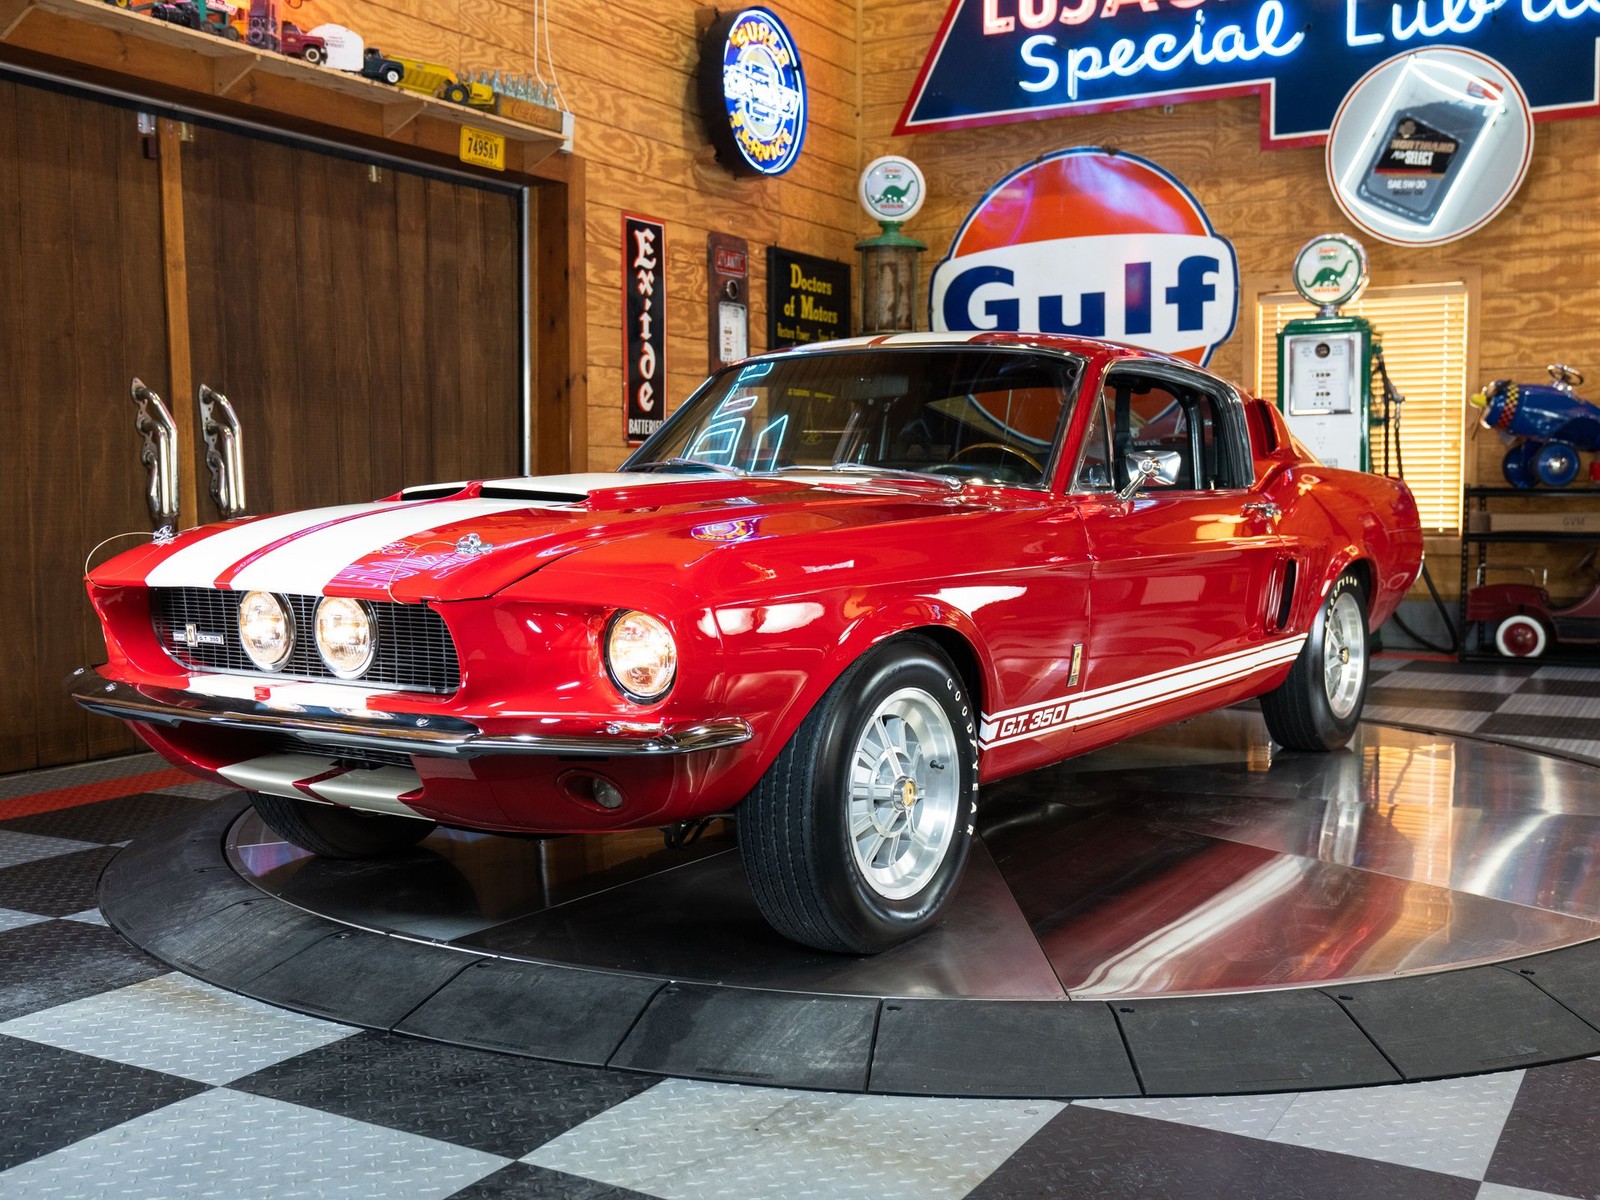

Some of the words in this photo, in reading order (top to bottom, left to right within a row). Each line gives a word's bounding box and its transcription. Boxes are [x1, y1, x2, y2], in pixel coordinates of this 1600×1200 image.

[731, 21, 790, 68] SUPER
[1019, 0, 1305, 100] Special
[790, 263, 832, 295] Doctors
[943, 255, 1219, 337] Gulf
[634, 228, 656, 412] Exide
[784, 295, 795, 317] of
[801, 294, 838, 324] Motors
[1030, 705, 1066, 730] 350
